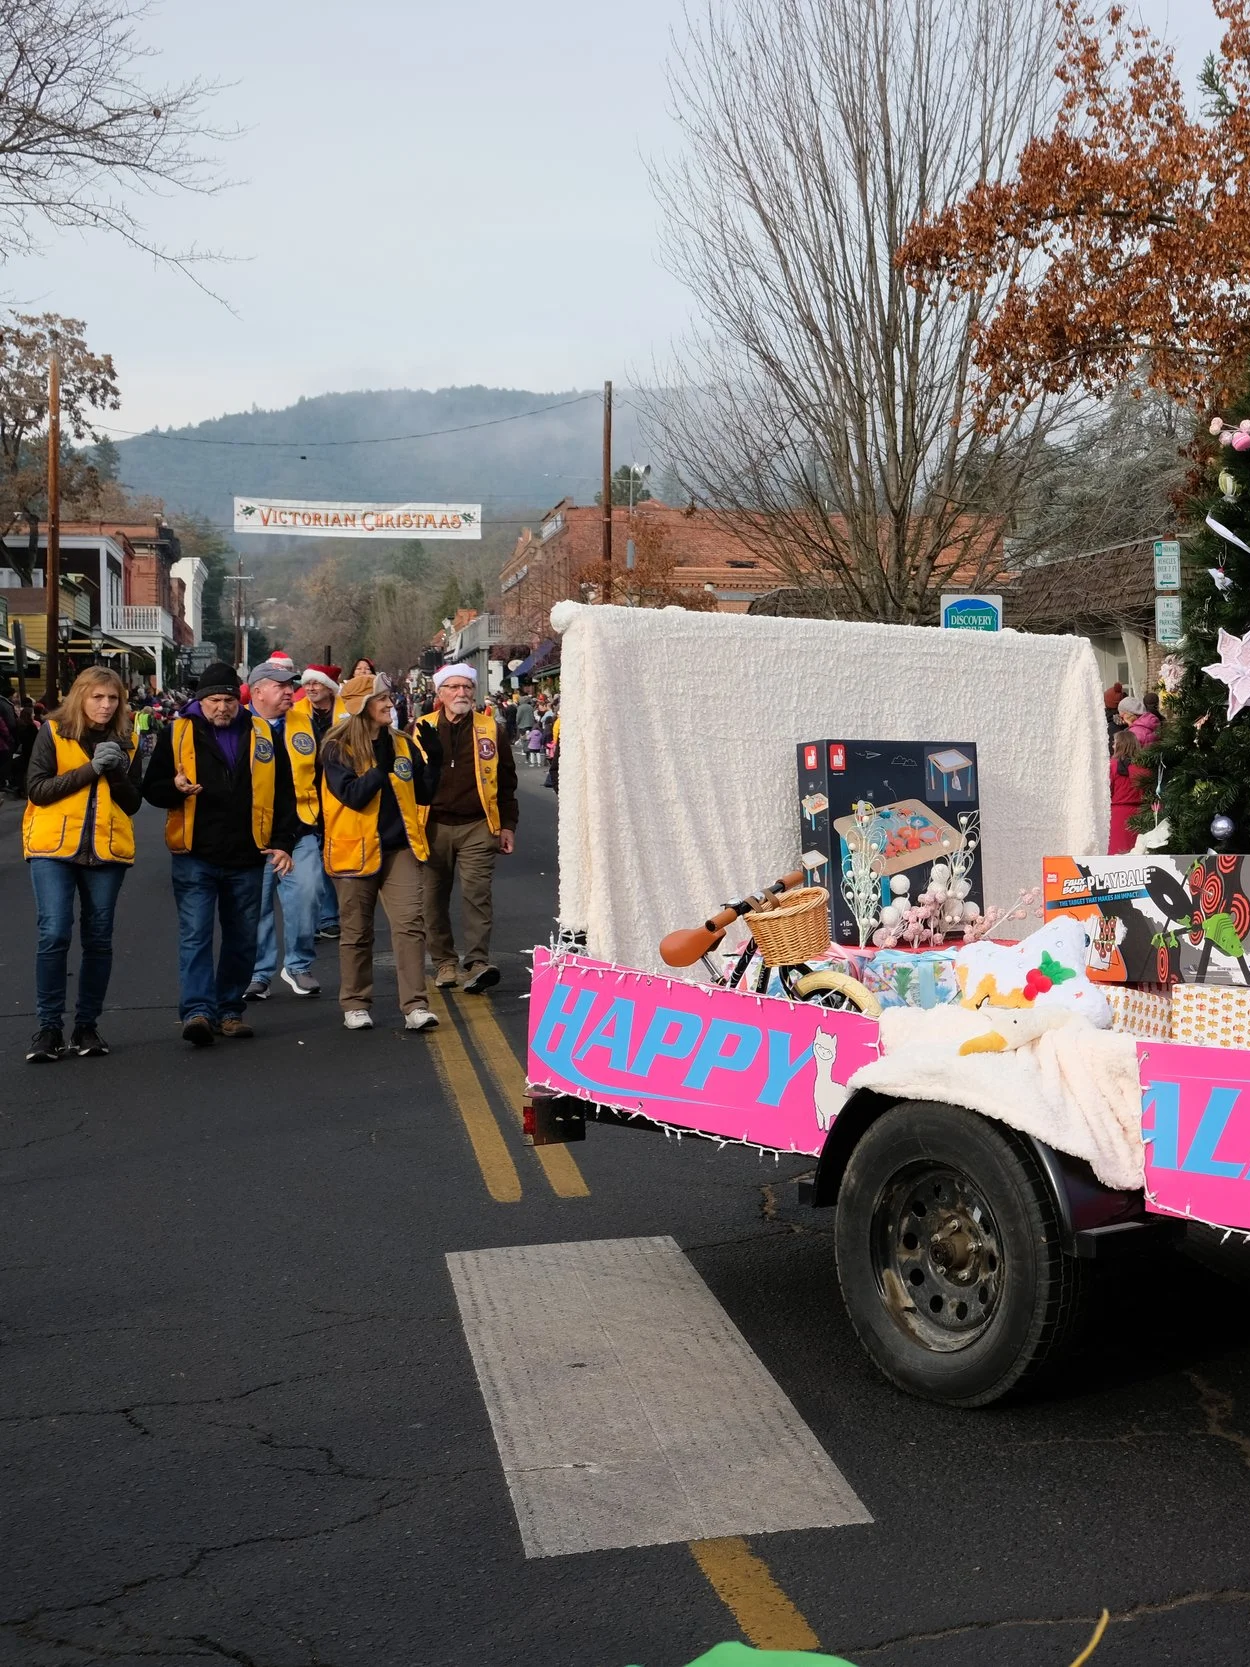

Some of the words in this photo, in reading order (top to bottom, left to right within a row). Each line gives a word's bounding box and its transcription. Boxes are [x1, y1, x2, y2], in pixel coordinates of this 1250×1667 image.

[258, 506, 356, 528] VICTORIAN
[360, 510, 462, 532] CHRISTMAS
[1157, 557, 1177, 565] VEHICLES
[951, 615, 993, 626] DISCOVERY
[1064, 877, 1086, 887] FAUX
[1062, 886, 1088, 895] BOW
[1098, 895, 1114, 903] MAKES
[531, 982, 815, 1108] HAPPY
